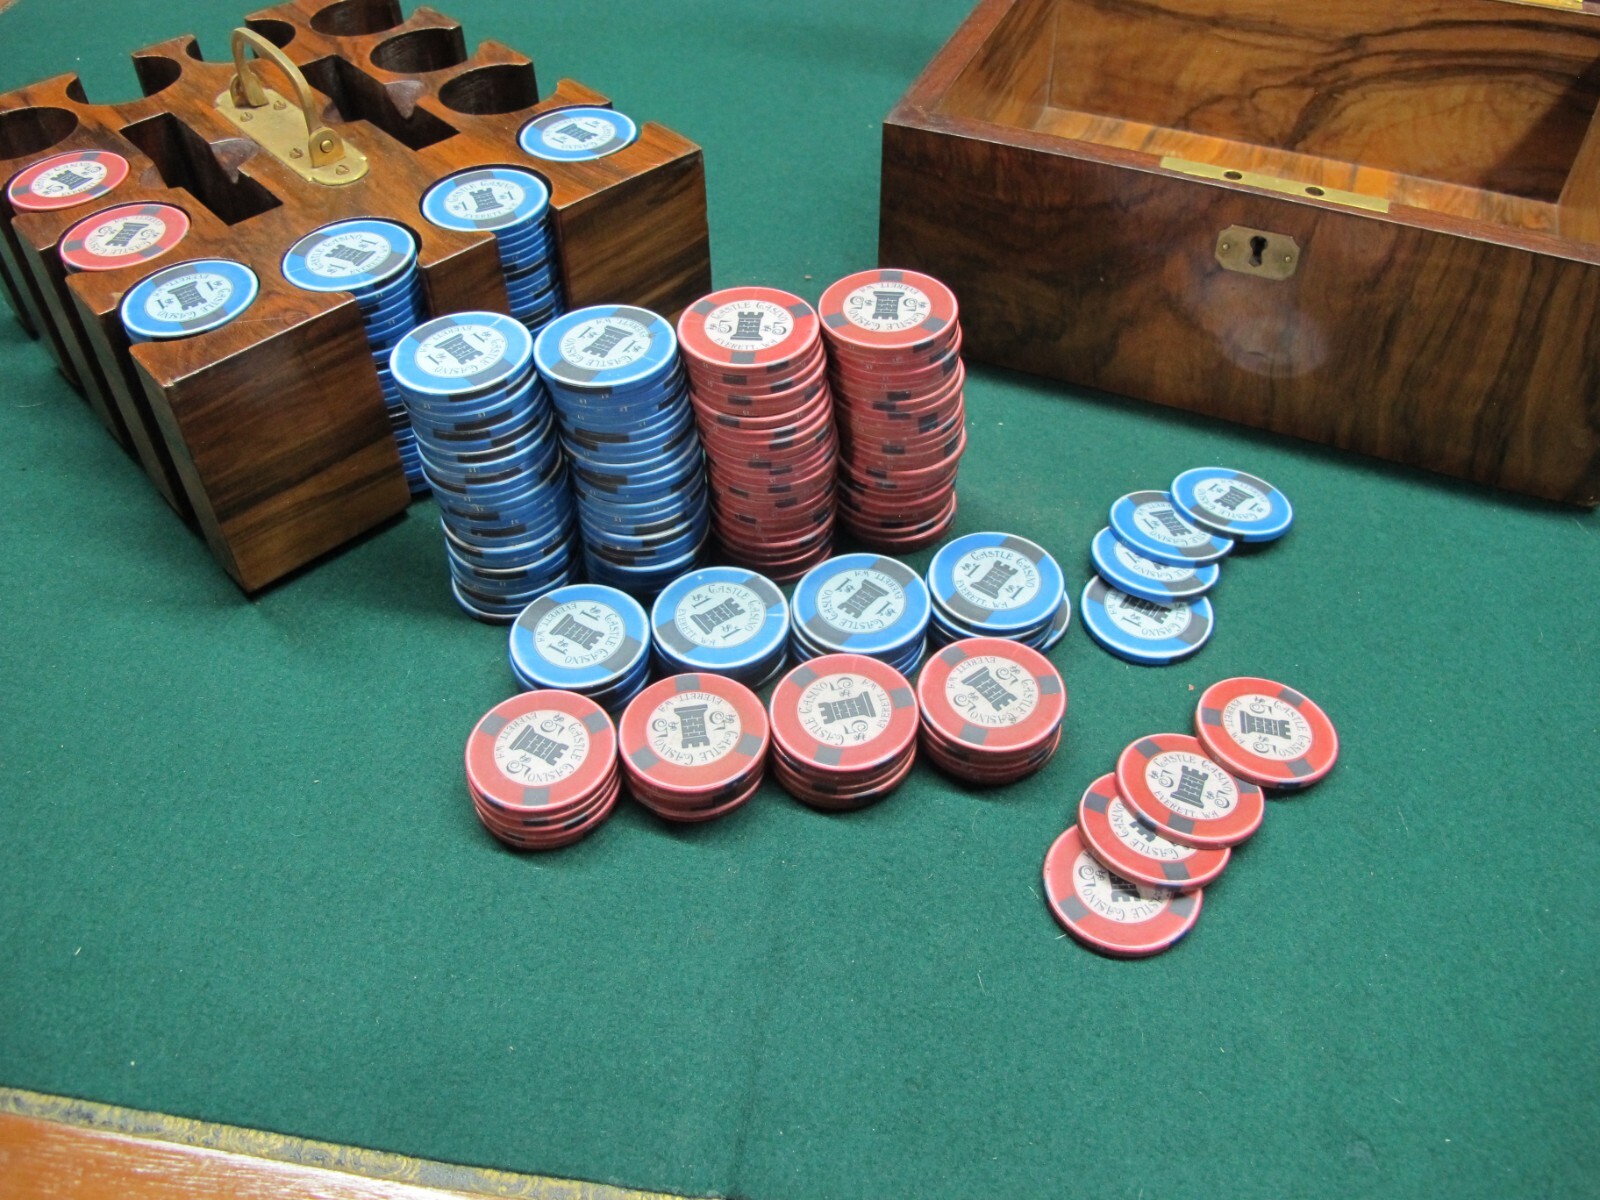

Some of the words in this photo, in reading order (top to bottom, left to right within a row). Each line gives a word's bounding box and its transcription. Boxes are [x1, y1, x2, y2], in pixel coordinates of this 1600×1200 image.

[850, 295, 876, 310] $5
[902, 297, 929, 312] $5
[577, 326, 598, 339] $1
[706, 320, 732, 334] $5
[760, 321, 787, 335] $5
[621, 340, 645, 353] $1
[425, 352, 447, 365] $1
[960, 562, 981, 578] $1
[970, 550, 1014, 561] CASTLE
[1015, 557, 1037, 589] CASINO
[833, 578, 856, 594] $1
[1005, 583, 1025, 601] $1
[691, 593, 712, 610] $1
[708, 584, 750, 600] CASTLE
[743, 599, 761, 632] CASINO
[821, 589, 839, 621] CASINO
[875, 600, 897, 617] $1
[580, 605, 602, 622] $1
[838, 618, 885, 630] CASTLE
[1121, 613, 1143, 628] $1
[604, 613, 619, 647] CASTLE
[720, 623, 743, 641] $1
[547, 639, 569, 655] $1
[564, 648, 608, 665] CASINO
[995, 664, 1021, 687] $5
[798, 680, 828, 714] CASINO
[829, 676, 854, 697] $5
[1015, 678, 1035, 715] CASTLE
[953, 691, 980, 713] $5
[1248, 696, 1274, 715] $5
[540, 713, 566, 738] $5
[709, 710, 738, 731] $5
[969, 710, 1018, 725] CASINO
[1272, 700, 1309, 733] CASTLE
[651, 718, 680, 739] $5
[804, 717, 845, 746] CASTLE
[843, 720, 869, 741] $5
[567, 721, 587, 762] CASTLE
[654, 738, 694, 766] CASINO
[699, 730, 739, 761] CASTLE
[1252, 735, 1278, 755] $5
[1278, 734, 1311, 758] CASINO
[506, 753, 532, 778] $5
[527, 762, 576, 783] CASINO
[1152, 754, 1197, 768] CASTLE
[1200, 759, 1234, 793] CASINO
[1148, 769, 1175, 788] $5
[1203, 789, 1231, 809] $5
[1111, 802, 1130, 838] CASINO
[1128, 838, 1179, 860] CASTLE
[1077, 864, 1108, 888] $5
[1081, 888, 1127, 921] CASINO
